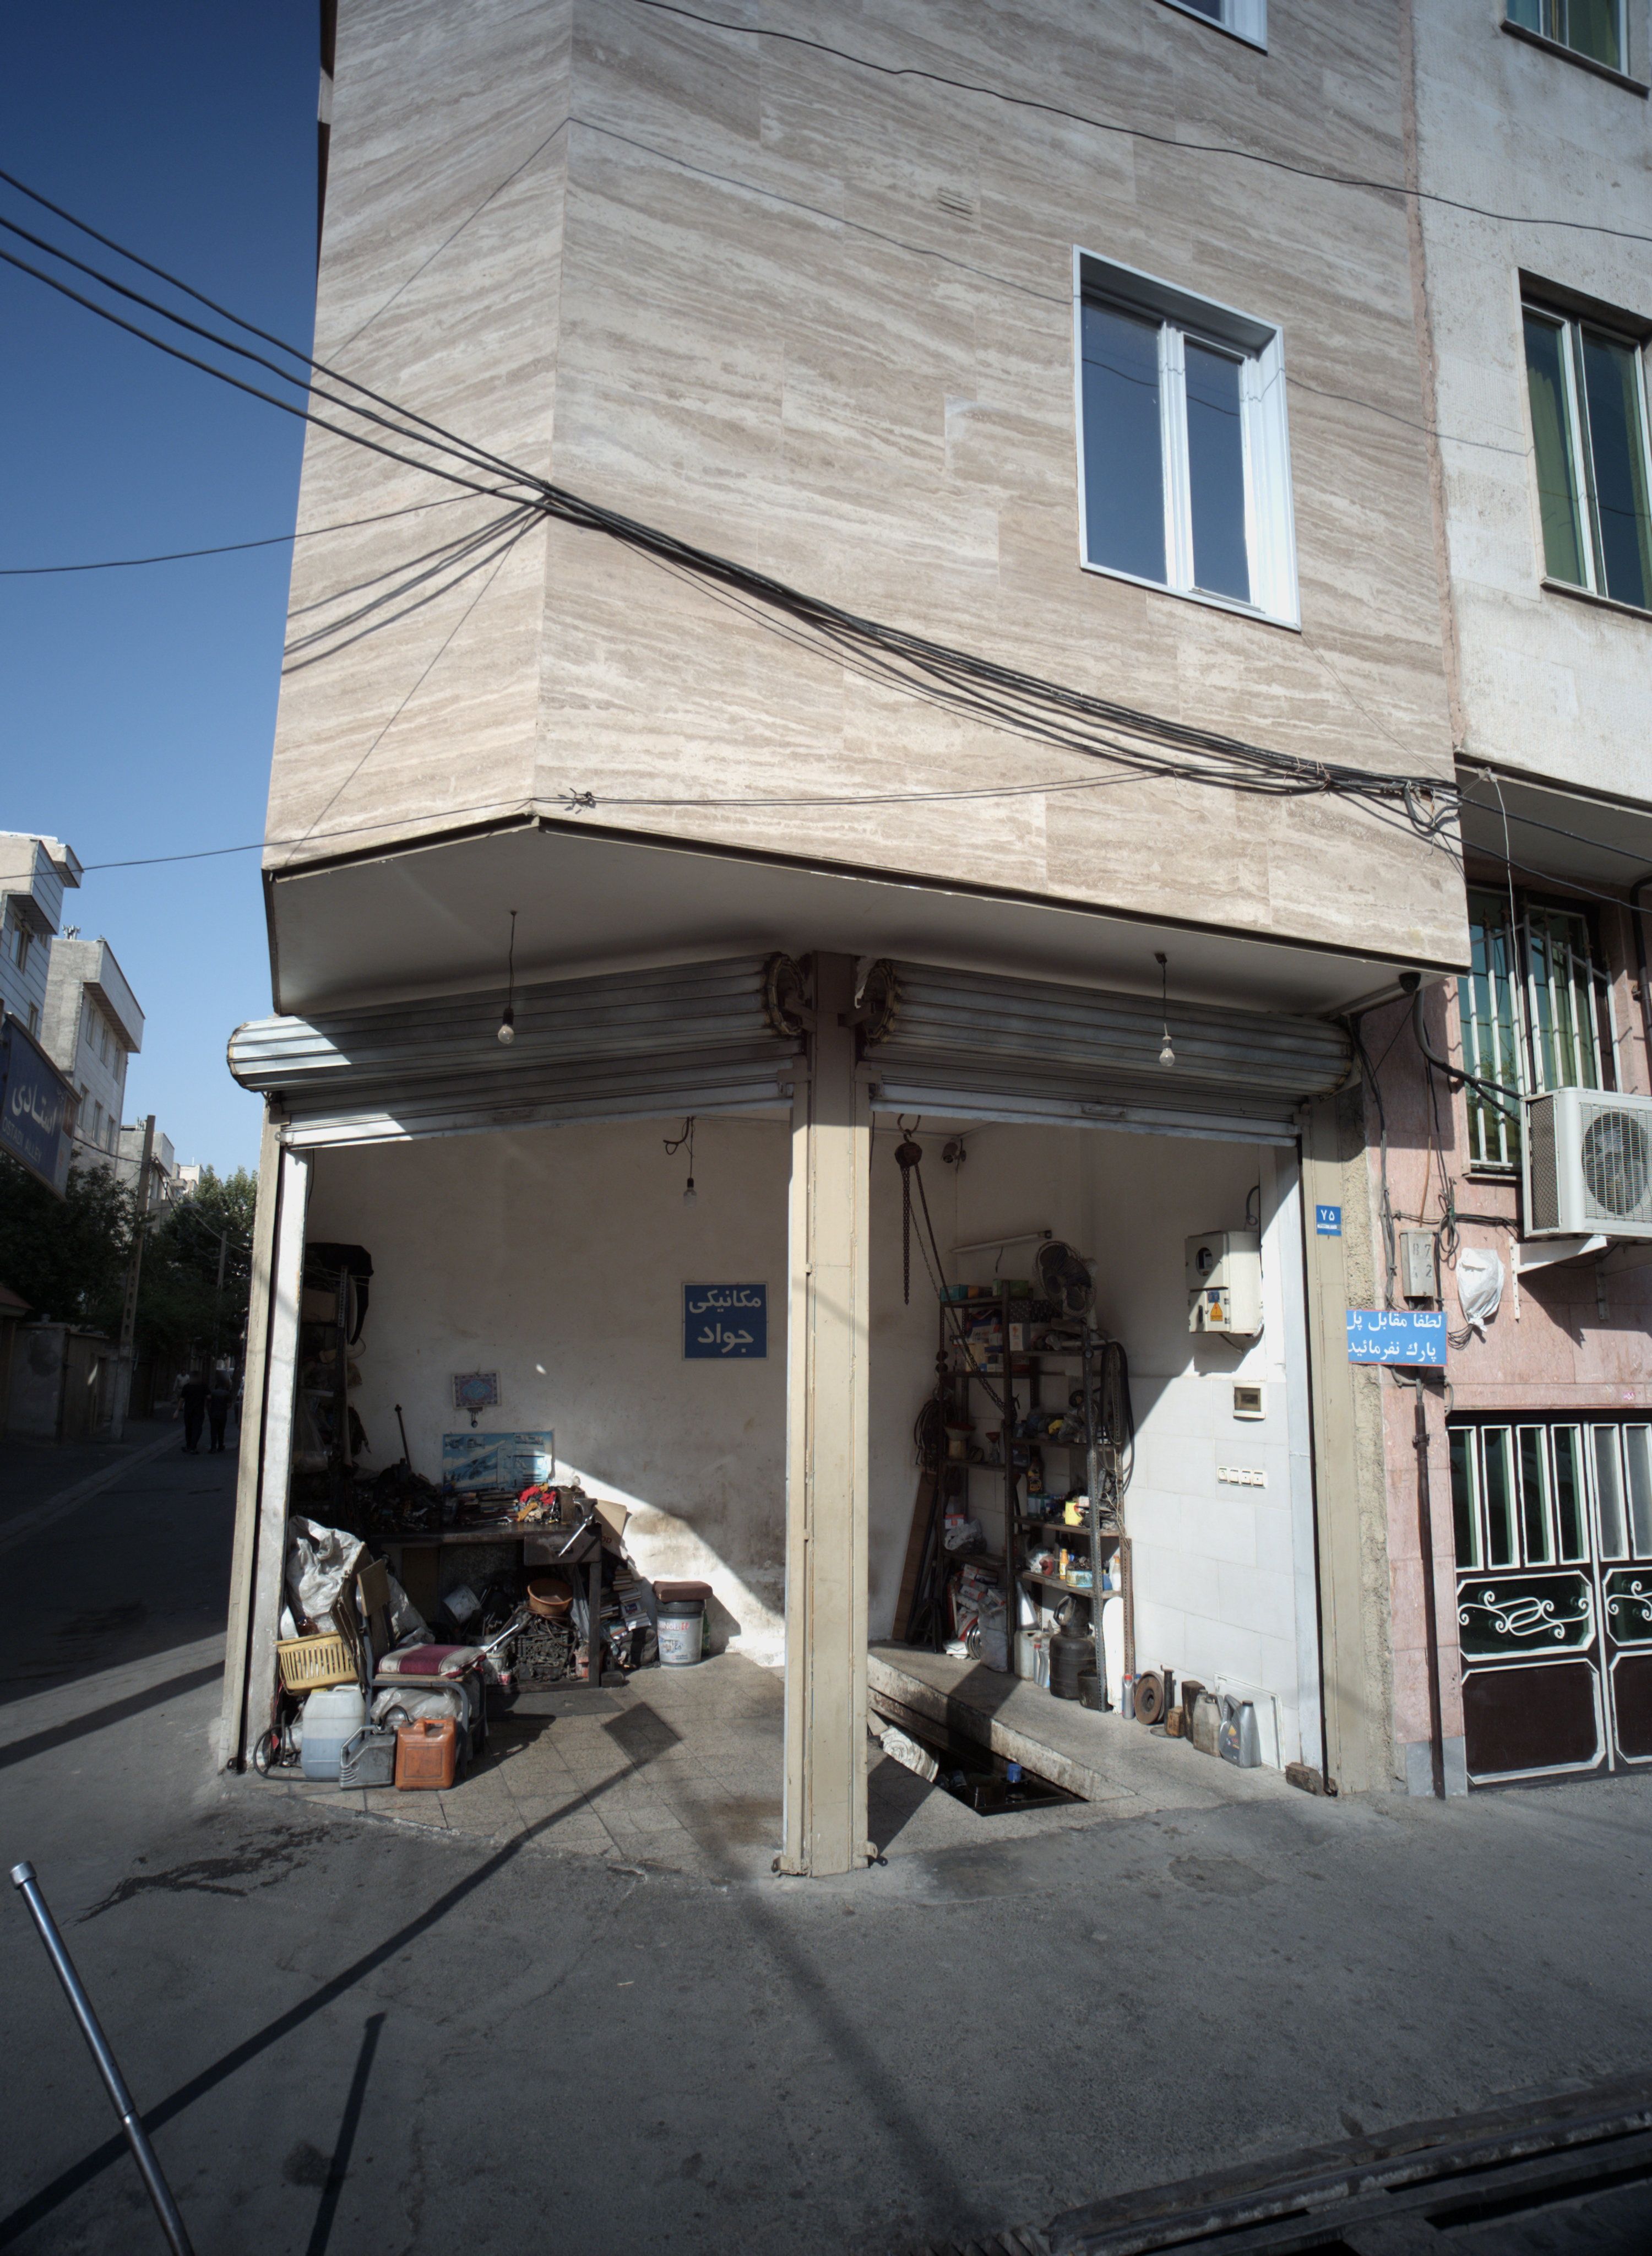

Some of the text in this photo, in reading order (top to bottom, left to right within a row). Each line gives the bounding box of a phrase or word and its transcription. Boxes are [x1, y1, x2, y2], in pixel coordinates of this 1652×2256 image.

[12, 1084, 57, 1137] استادی
[1320, 1209, 1335, 1221] ۷۵
[689, 1289, 762, 1314] مکانیکی
[1346, 1311, 1442, 1331] لطفا مقابل پل
[697, 1323, 754, 1353] جواد
